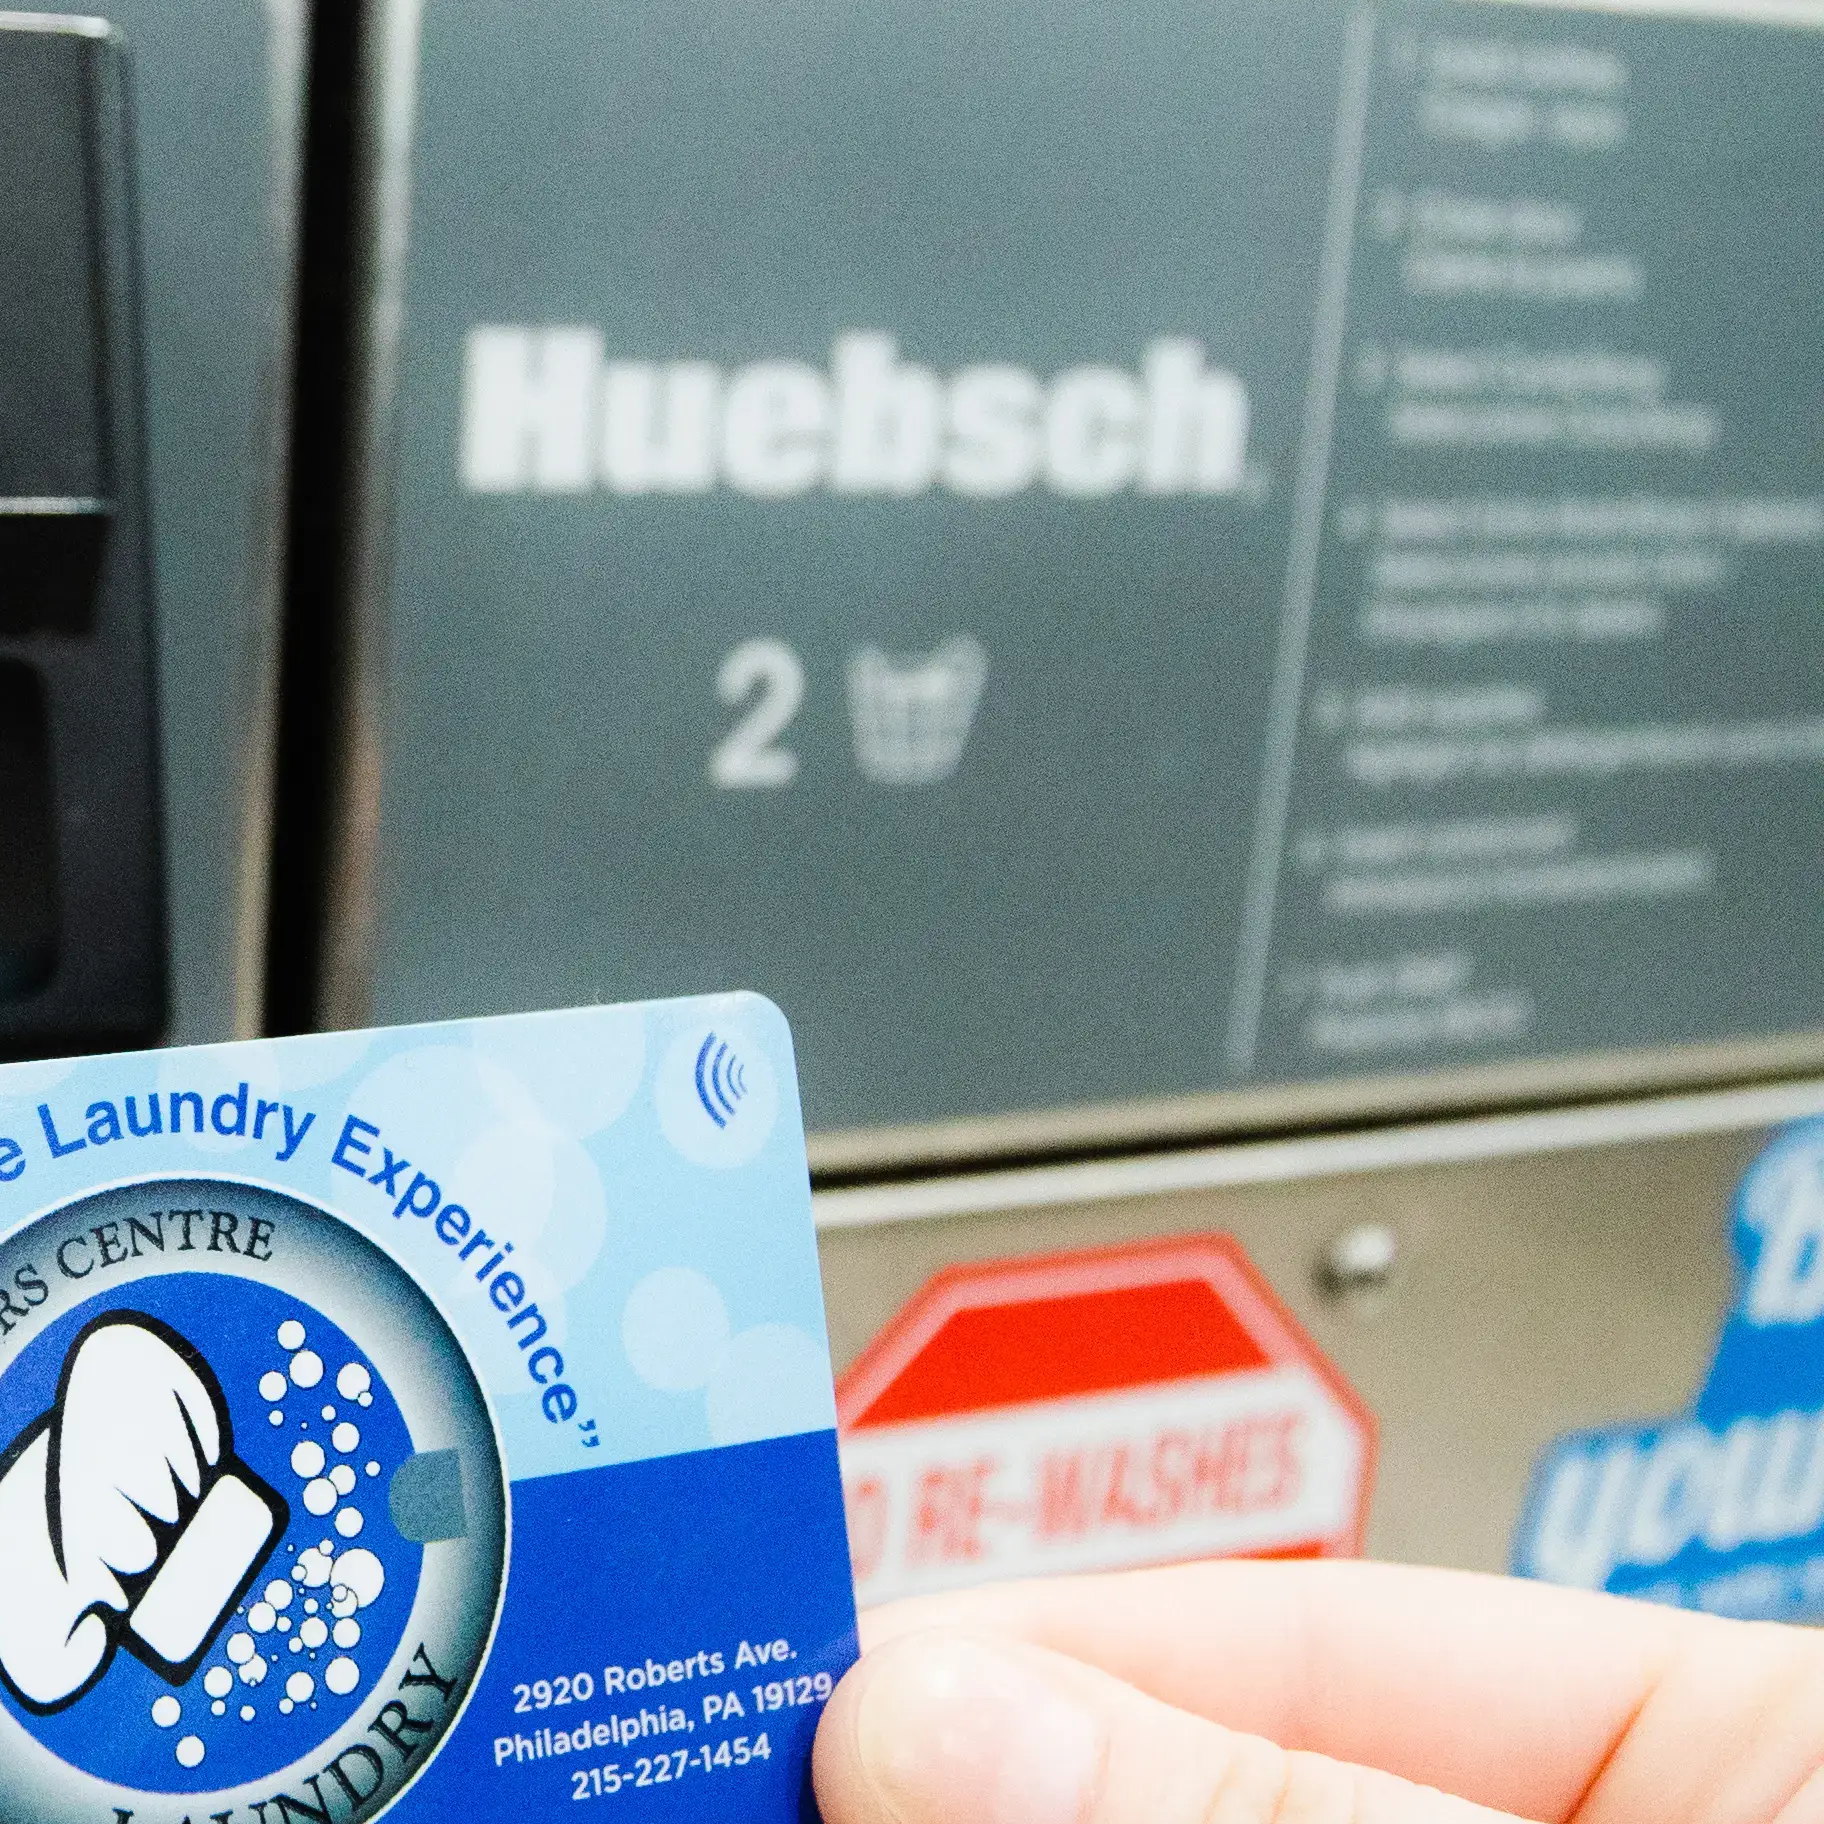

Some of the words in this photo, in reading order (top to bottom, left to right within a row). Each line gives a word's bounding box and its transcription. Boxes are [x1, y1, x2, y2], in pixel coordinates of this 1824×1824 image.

[464, 326, 1254, 494] Huebsch
[708, 638, 806, 788] 2
[37, 1082, 316, 1161] Laundry
[56, 1208, 275, 1282] CENTRE
[512, 1672, 593, 1714] 2920
[603, 1651, 725, 1695] Roberts
[734, 1638, 798, 1670] Ave.
[493, 1705, 695, 1766] Philadelphia,
[702, 1694, 745, 1724] PA
[751, 1672, 833, 1714] 19129
[570, 1732, 772, 1801] 215-227-1454
